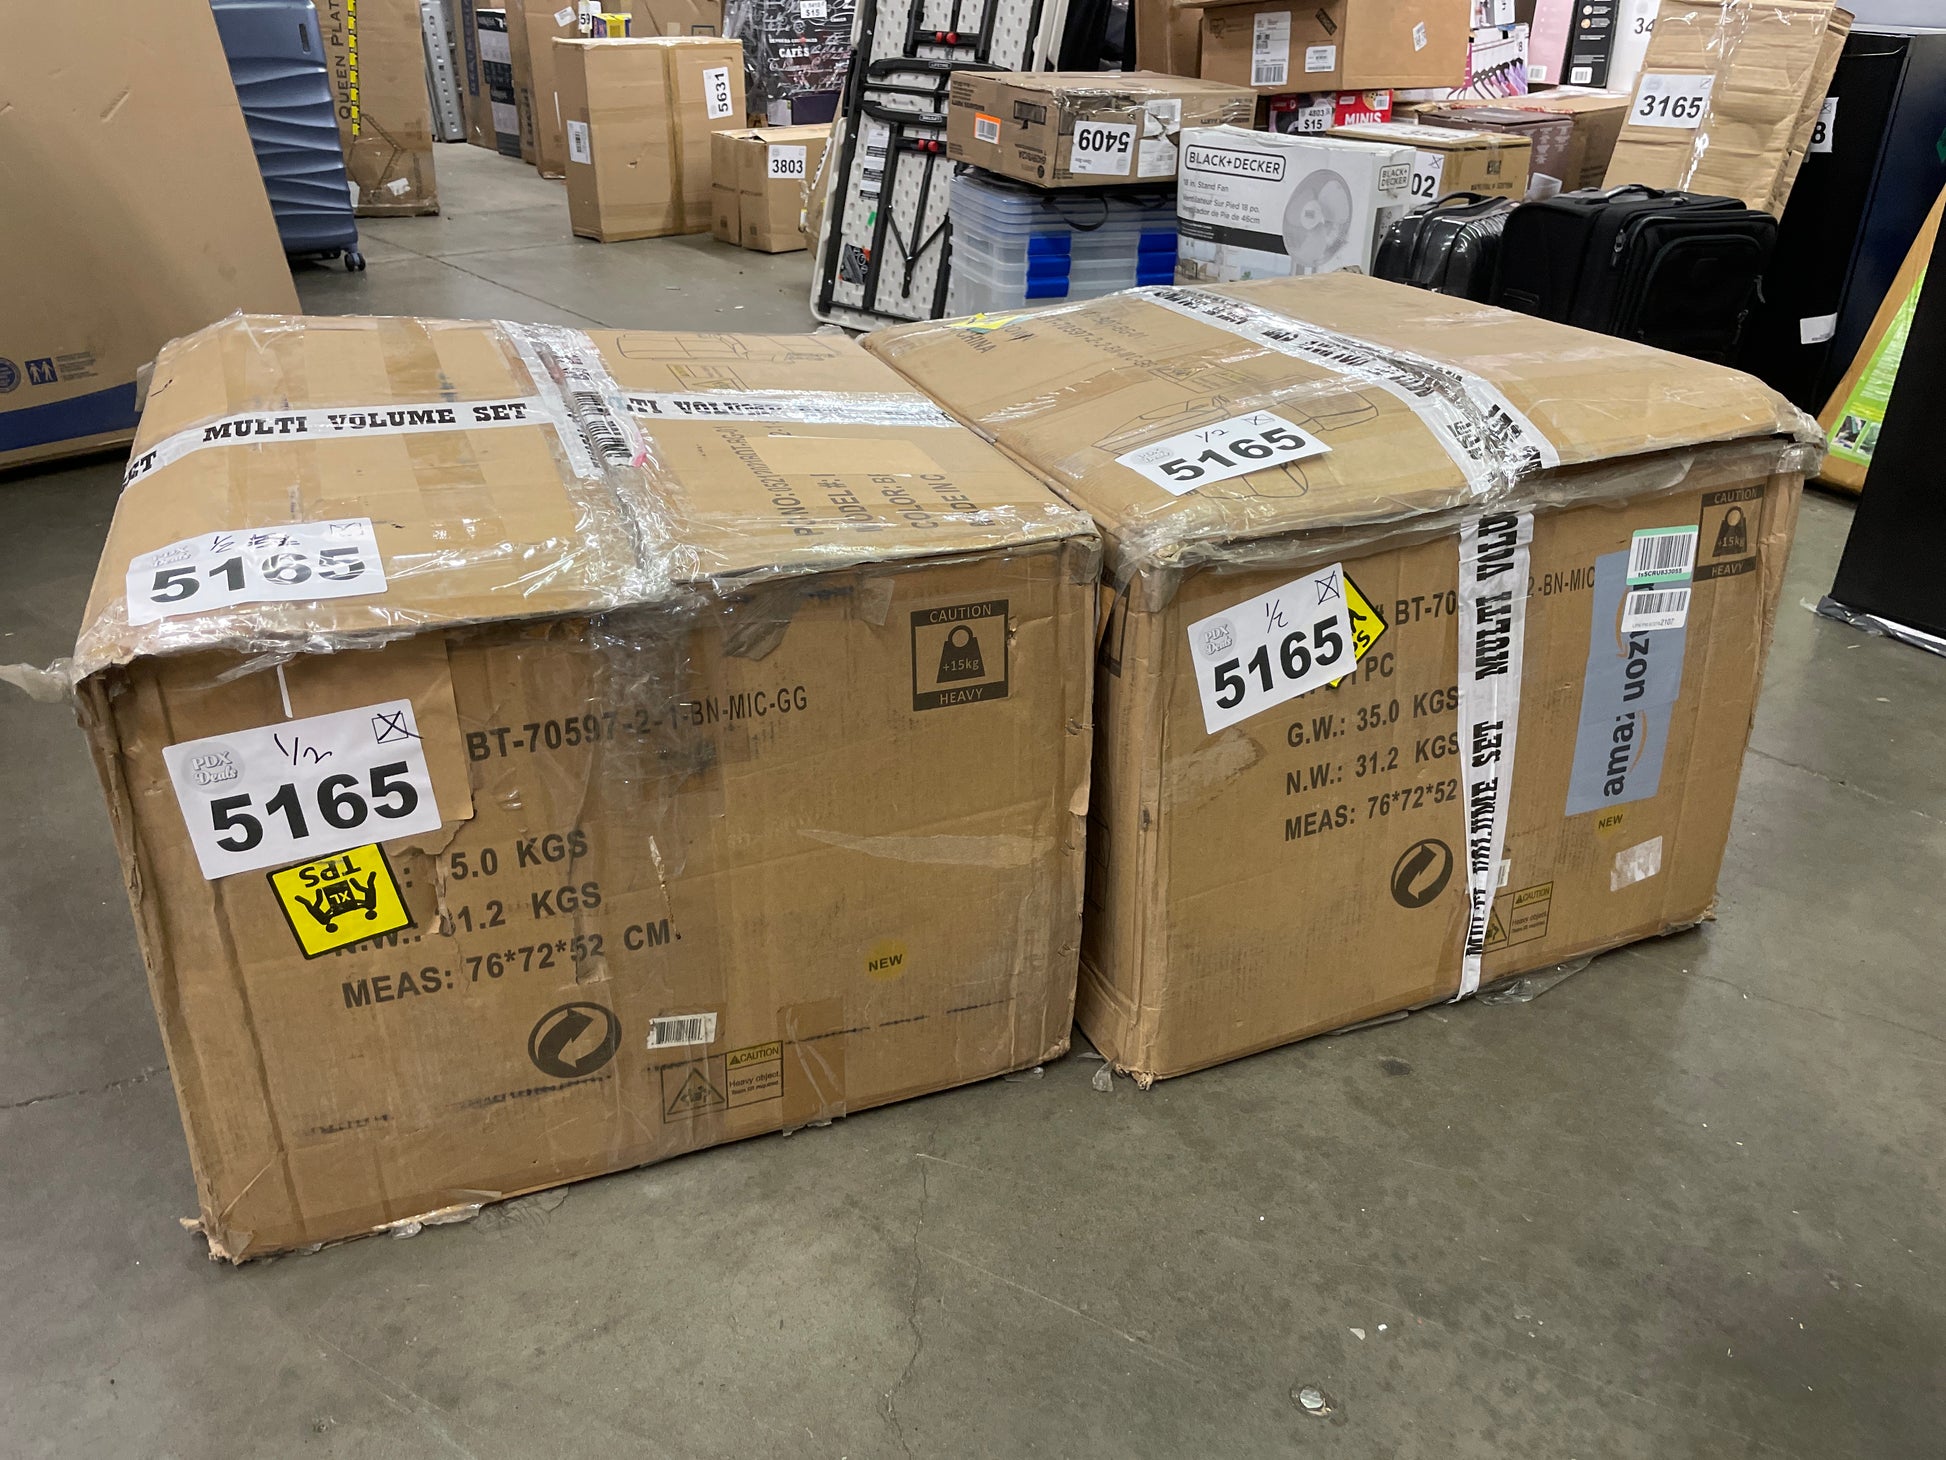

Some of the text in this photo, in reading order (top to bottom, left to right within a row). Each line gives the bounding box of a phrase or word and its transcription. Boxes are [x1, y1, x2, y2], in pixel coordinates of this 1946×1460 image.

[335, 56, 351, 119] QUEEN
[715, 72, 729, 112] 5631
[1308, 109, 1325, 117] 4803
[1639, 94, 1703, 119] 3165
[1304, 119, 1323, 130] $15
[1344, 112, 1382, 125] MINIS
[1078, 129, 1130, 153] 5409
[772, 159, 804, 174] 3803
[1189, 152, 1280, 175] BLACK+DECKER
[1197, 182, 1216, 191] Stand
[1217, 183, 1229, 192] Fan
[1211, 209, 1219, 218] de
[1220, 210, 1230, 219] Pie
[1231, 212, 1240, 221] de
[1214, 199, 1225, 208] Sur
[1226, 201, 1241, 210] Pied
[1242, 203, 1248, 211] 18
[202, 402, 529, 442] MULTI VOLUME SET
[1159, 427, 1306, 481] 5165
[1714, 489, 1757, 504] CAUTION
[150, 546, 366, 603] 5165
[1711, 562, 1744, 576] HEAVY
[929, 604, 992, 624] CAUTION
[1204, 623, 1230, 644] PDX
[1475, 591, 1513, 681] MULTI
[942, 657, 980, 675] +15kg
[1214, 614, 1343, 709] 5165
[1365, 652, 1394, 682] PC
[939, 687, 984, 705] HEAVY
[465, 686, 808, 763] BT-70597-2-1-BN-MIC-GG
[1287, 685, 1460, 748] G.W.: 35.0 KGS
[192, 750, 231, 771] PDX
[1285, 733, 1460, 796] N.W.: 31.2 KGS
[195, 764, 239, 787] Deals
[210, 761, 420, 853] 5165
[1284, 805, 1357, 843] MEAS:
[1598, 813, 1624, 830] NEW
[516, 830, 590, 870] KGS
[299, 855, 361, 888] TPS
[330, 890, 351, 905] XL
[531, 881, 602, 920] KGS
[1522, 886, 1551, 901] CAUTION
[868, 953, 904, 974] NEW
[342, 966, 454, 1009] MEAS:
[740, 1046, 779, 1062] CAUTION
[729, 1077, 754, 1088] Heavy
